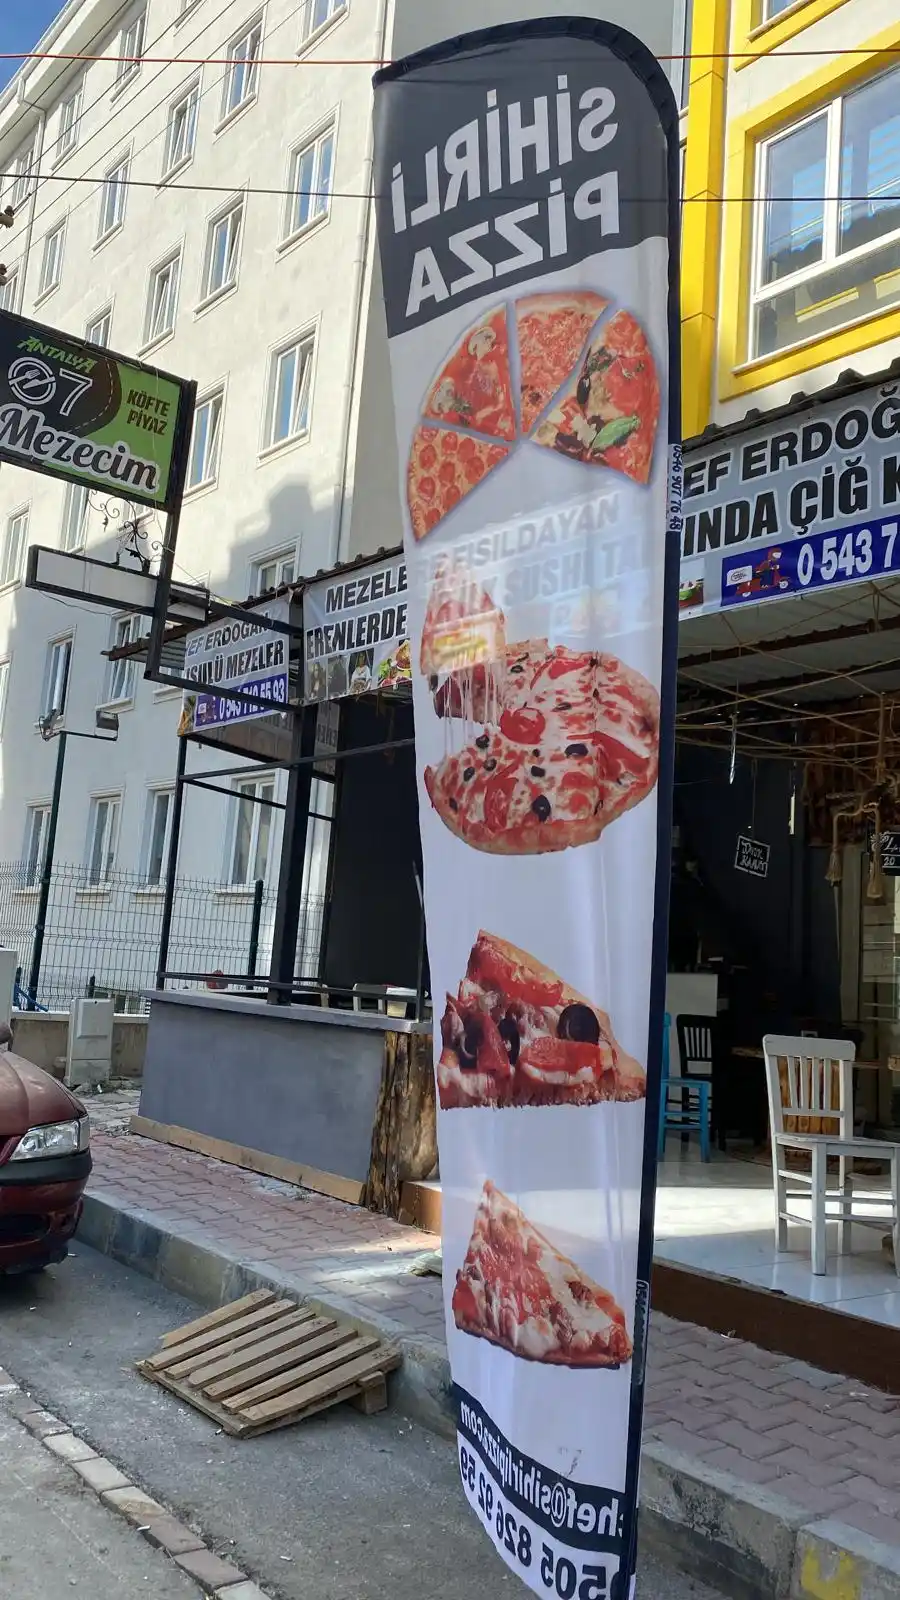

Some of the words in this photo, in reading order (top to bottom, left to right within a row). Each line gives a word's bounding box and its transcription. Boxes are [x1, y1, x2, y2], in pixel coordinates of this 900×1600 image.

[126, 408, 168, 435] PİYAZ
[127, 390, 170, 417] KÖFTE
[742, 384, 900, 481] ERDOĞ
[0, 409, 157, 490] Mezecim
[790, 455, 869, 536] ÇİĞ
[797, 543, 815, 586] 0
[820, 529, 873, 581] 543
[881, 522, 898, 568] 7
[226, 639, 284, 680] MEZELER
